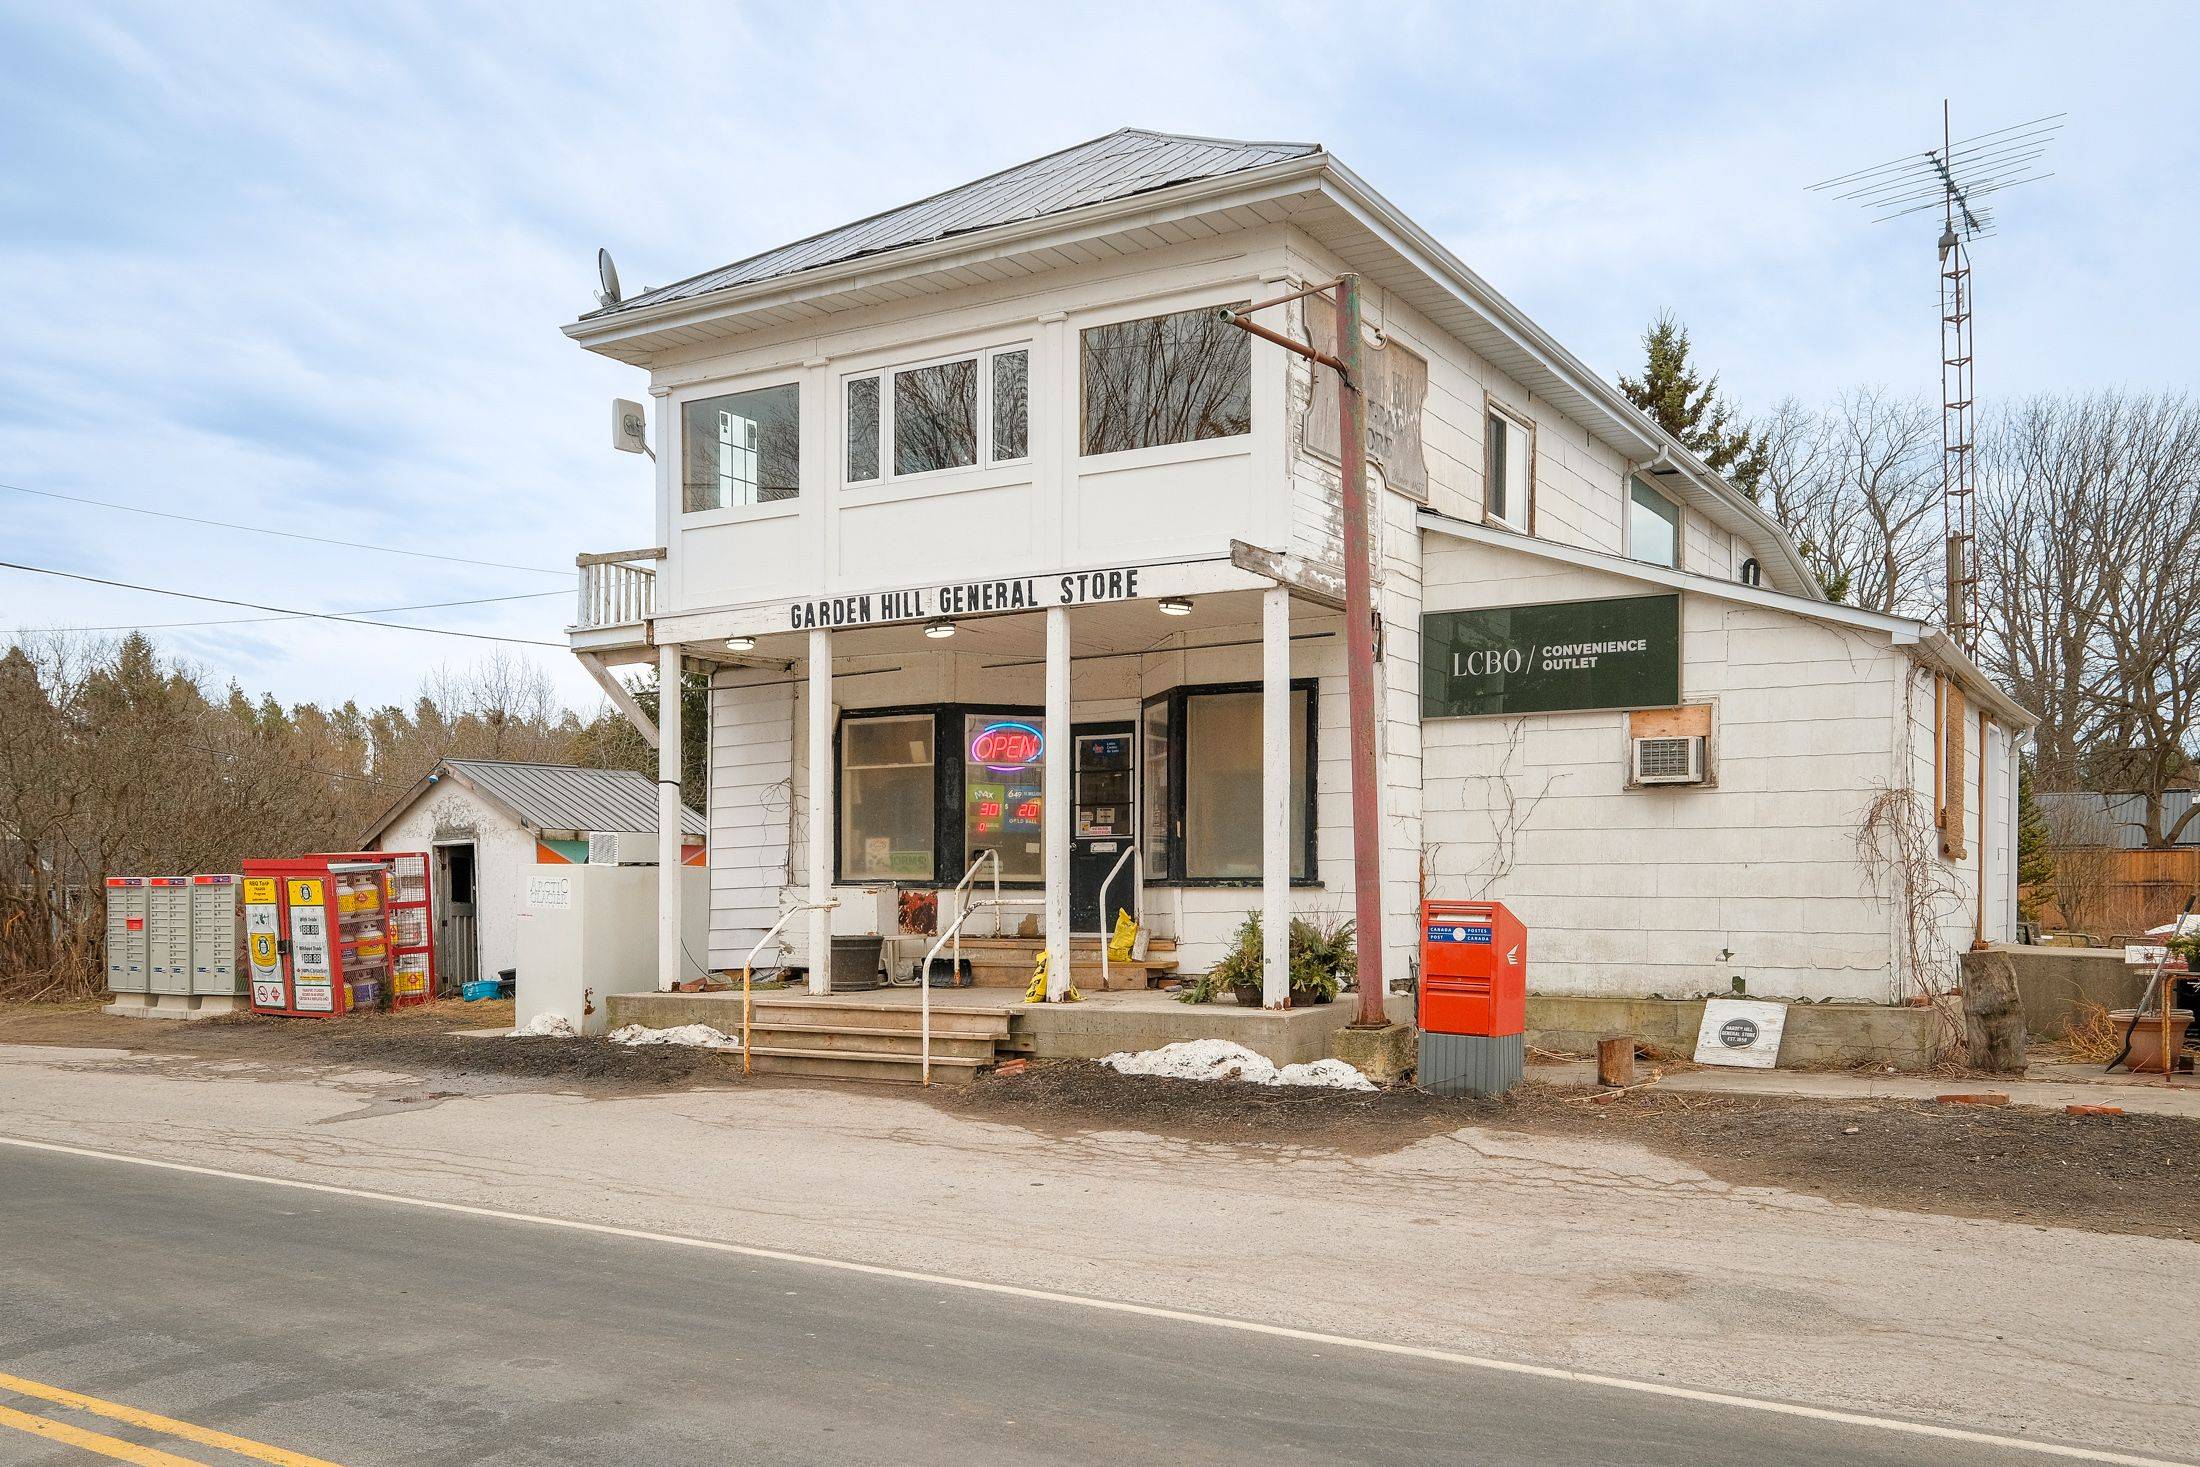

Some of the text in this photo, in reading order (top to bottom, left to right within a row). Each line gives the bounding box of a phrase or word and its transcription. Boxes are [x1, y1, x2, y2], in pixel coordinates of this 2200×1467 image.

[791, 569, 1139, 629] GARDEN HILL GENERAL STORE
[1542, 639, 1647, 657] CONVENIENCE
[1542, 657, 1598, 671] OUTLET
[976, 735, 1038, 759] OPEN
[974, 790, 994, 800] MAX
[1008, 789, 1022, 798] 649
[980, 803, 998, 815] 30
[1018, 804, 1037, 816] 20
[530, 877, 568, 893] ARCTIC
[530, 892, 568, 904] GLACIER
